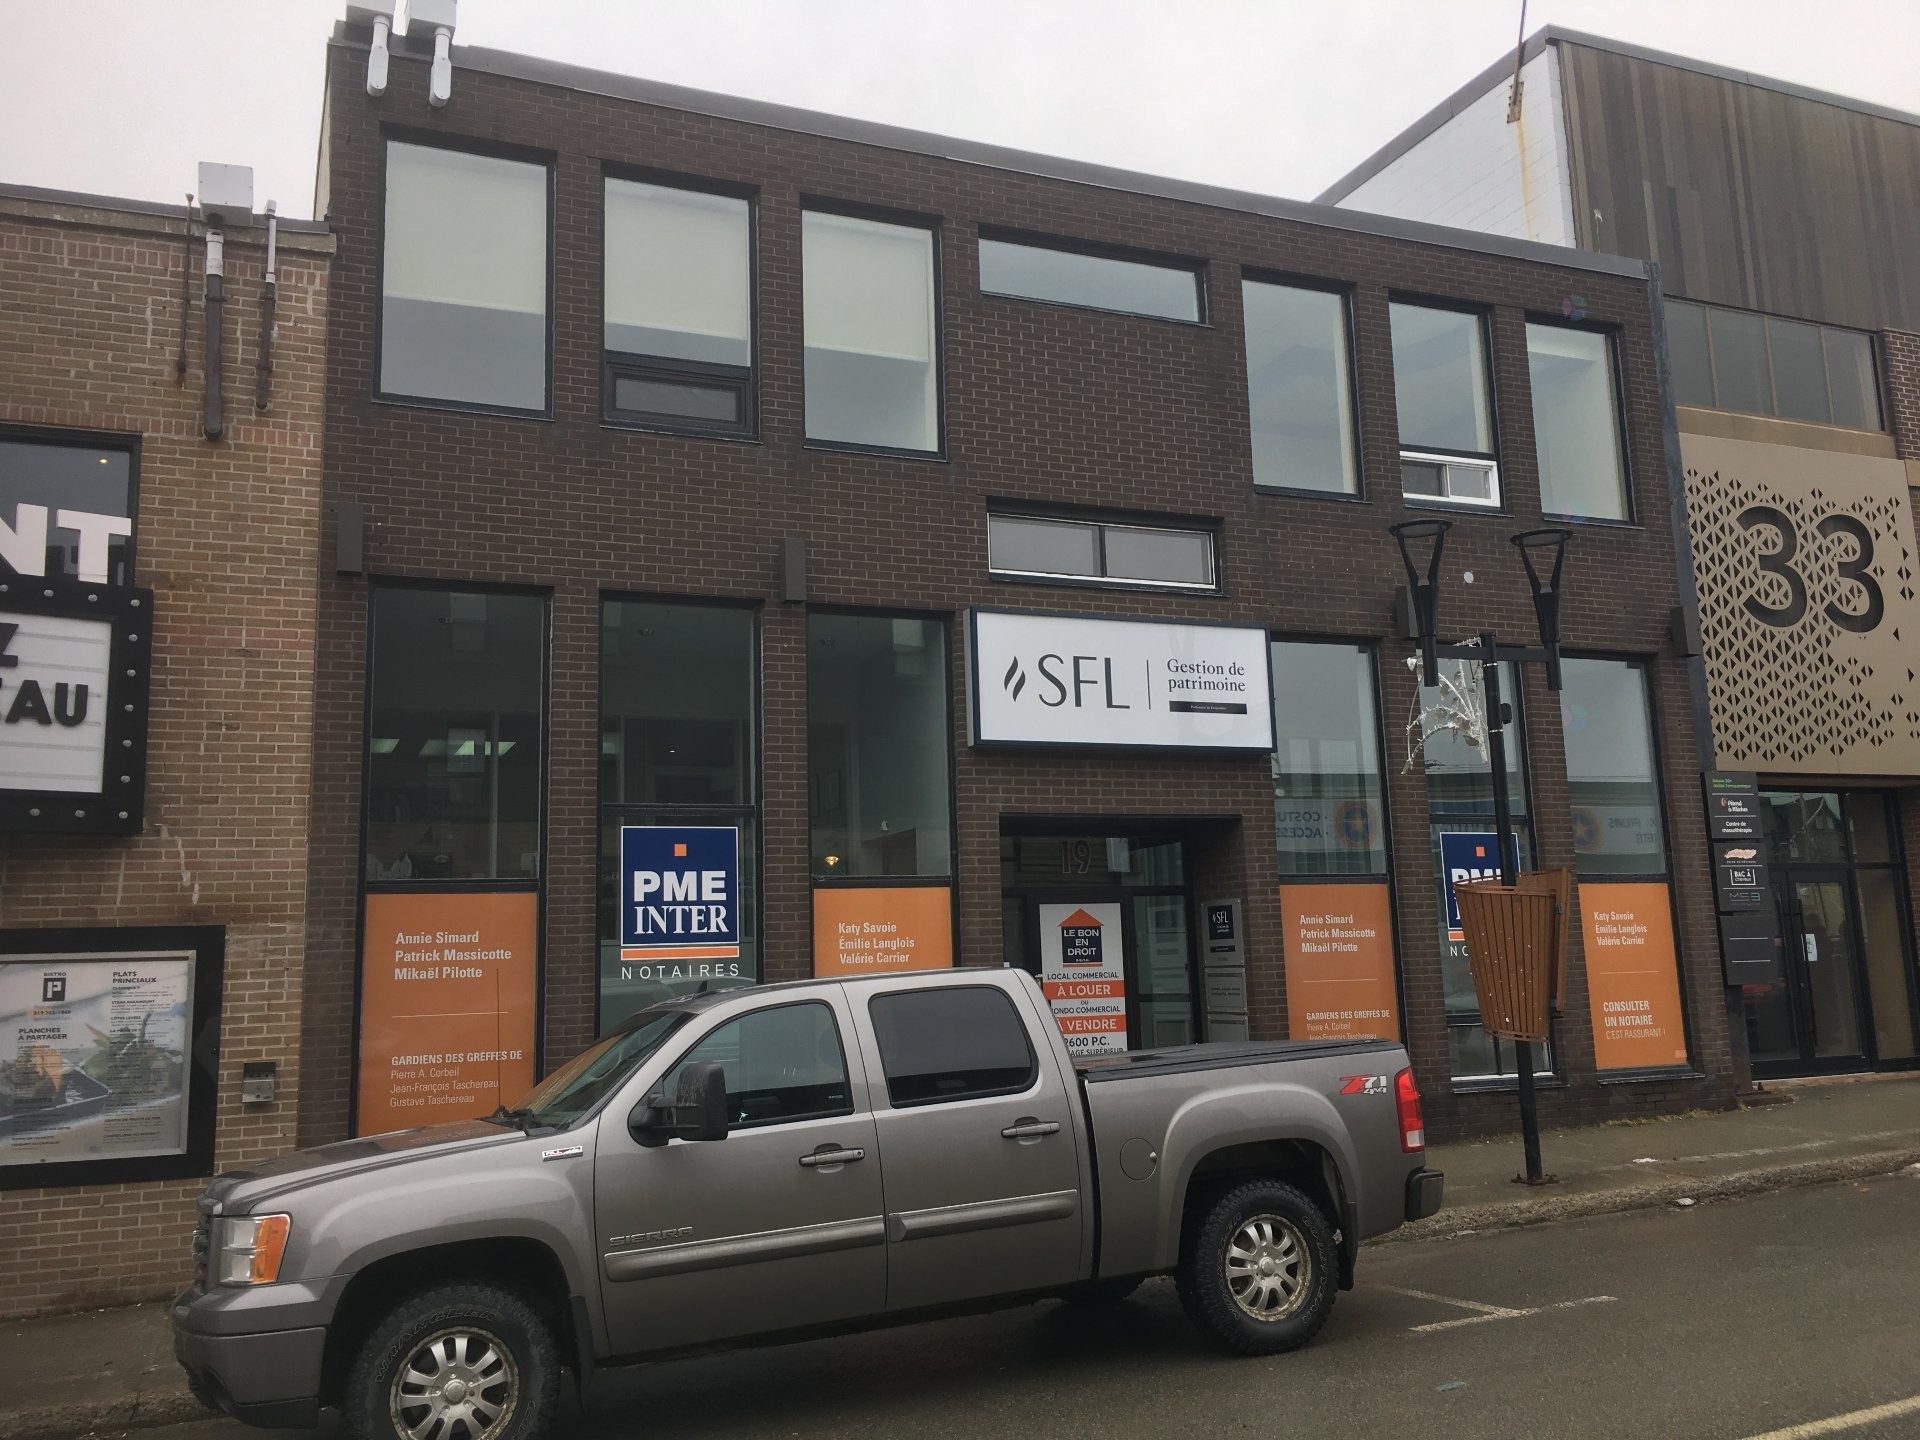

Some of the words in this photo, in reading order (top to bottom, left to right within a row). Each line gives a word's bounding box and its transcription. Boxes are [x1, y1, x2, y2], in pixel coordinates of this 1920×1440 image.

[1736, 506, 1884, 633] 33
[1167, 659, 1224, 674] Gestion
[1228, 662, 1245, 675] de
[1037, 654, 1130, 709] SFL
[1168, 676, 1246, 692] patrimoine
[0, 679, 88, 727] AU
[1062, 839, 1091, 873] 19
[634, 871, 727, 901] PME
[634, 905, 730, 934] INTER
[1300, 914, 1324, 924] Annie
[1325, 914, 1353, 924] Simard
[1593, 911, 1610, 922] Katy
[1611, 911, 1634, 920] Savoie
[838, 922, 860, 935] Katy
[863, 921, 897, 933] Savoie
[1300, 929, 1329, 938] Patrick
[1331, 928, 1376, 938] Massicotte
[1595, 923, 1617, 933] Émilie
[1618, 923, 1648, 934] Langlois
[395, 932, 432, 944] Annie
[436, 931, 479, 943] Simard
[839, 936, 870, 949] Émilie
[873, 937, 915, 950] Langlois
[1067, 948, 1097, 956] DROIT
[1301, 942, 1330, 952] Mikaël
[1332, 942, 1358, 952] Pilotte
[395, 950, 440, 961] Patrick
[444, 949, 512, 960] Massicotte
[840, 953, 873, 964] Valérie
[876, 952, 910, 962] Carrier
[395, 967, 438, 980] Mikaël
[443, 967, 483, 979] Pilotte
[622, 964, 740, 979] NOTAIRES
[1057, 983, 1066, 996] À
[1069, 985, 1110, 995] LOUER
[1603, 1001, 1650, 1011] CONSULTER
[1306, 1012, 1339, 1020] GARDIENS
[1341, 1011, 1352, 1019] DES
[1354, 1010, 1380, 1018] GREFFES
[1604, 1017, 1618, 1026] UN
[1619, 1015, 1653, 1025] NOTAIRE
[1066, 1019, 1117, 1030] VENDRE
[26, 1033, 67, 1041] PARTAGER
[1091, 1036, 1110, 1046] P.C.
[392, 1055, 442, 1066] GARDIENS
[446, 1053, 464, 1063] DES
[467, 1051, 507, 1061] GREFFES
[510, 1050, 522, 1059] DE
[390, 1069, 416, 1079] Pierre
[418, 1069, 427, 1078] A.
[430, 1067, 460, 1077] Corbeil
[390, 1082, 450, 1093] Jean-François
[453, 1080, 499, 1091] Taschereau
[1340, 1074, 1387, 1095] Z71
[390, 1097, 424, 1107] Gustave
[427, 1095, 475, 1105] Taschereau
